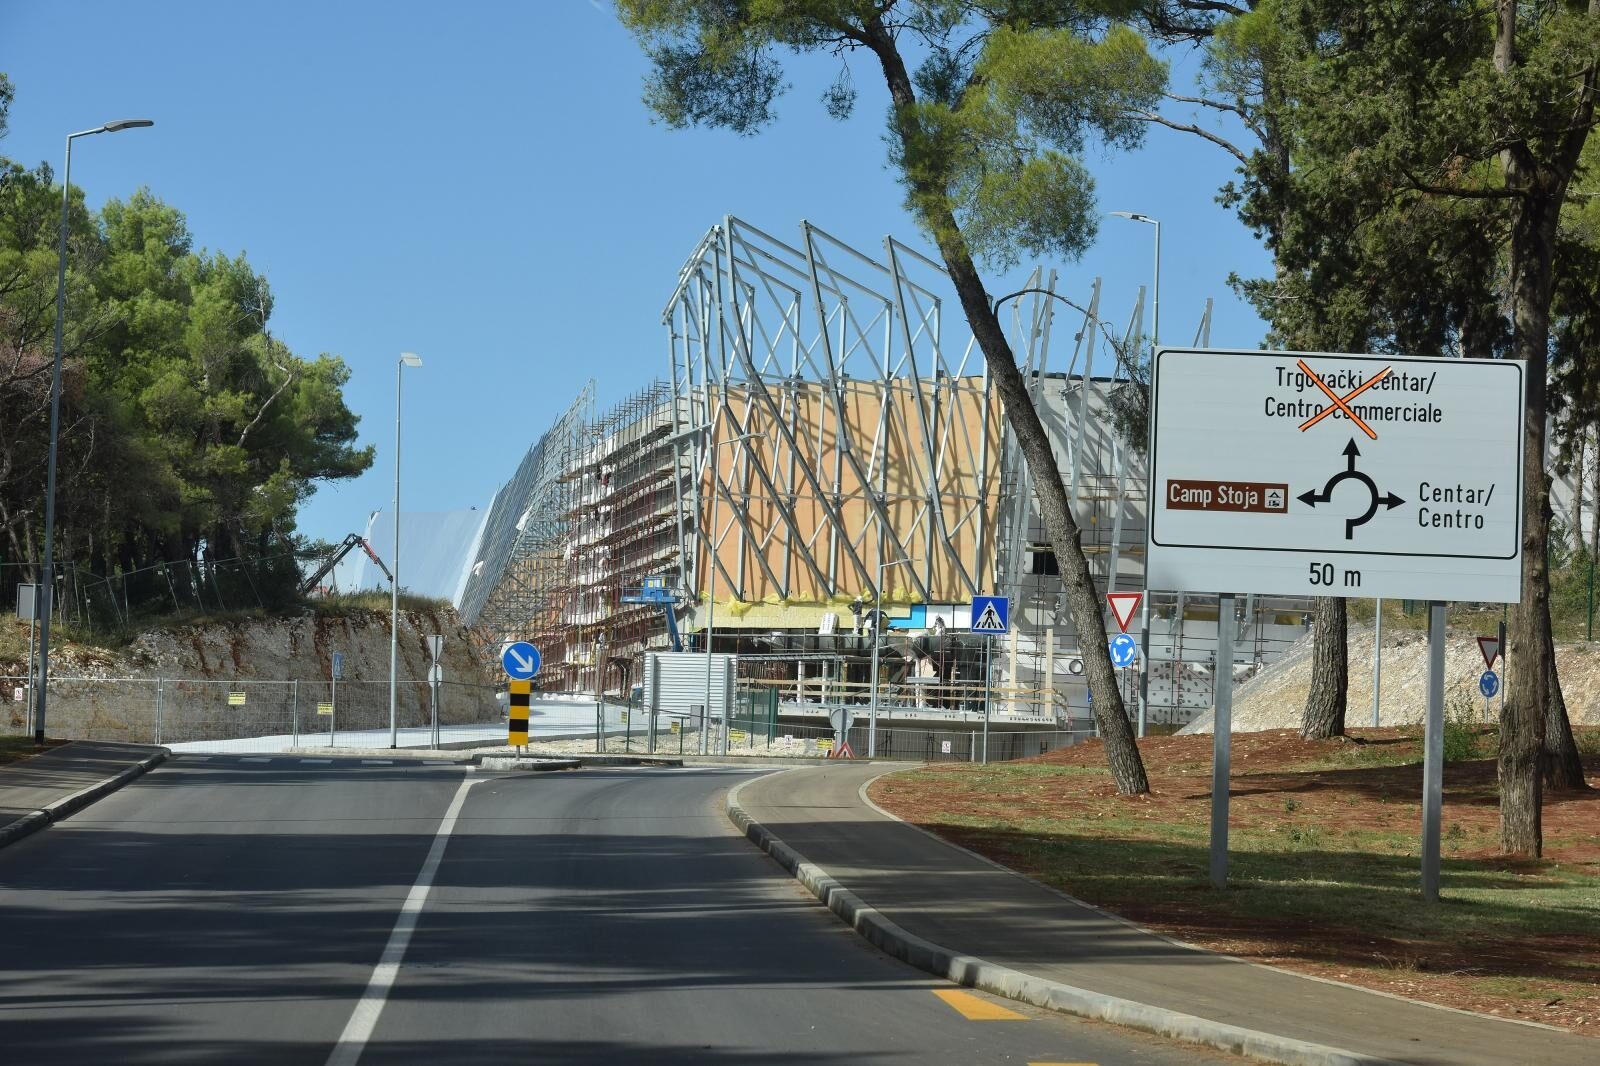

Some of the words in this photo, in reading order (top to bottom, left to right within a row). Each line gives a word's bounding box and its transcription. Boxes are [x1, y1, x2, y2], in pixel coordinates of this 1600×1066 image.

[1265, 396, 1323, 418] Centro
[1332, 402, 1442, 423] commerciale
[1170, 483, 1212, 508] Camp
[1217, 485, 1258, 510] Stoja
[1419, 481, 1495, 507] Centar/
[1418, 507, 1484, 529] Centro
[1309, 562, 1334, 586] 50
[1344, 570, 1361, 587] m
